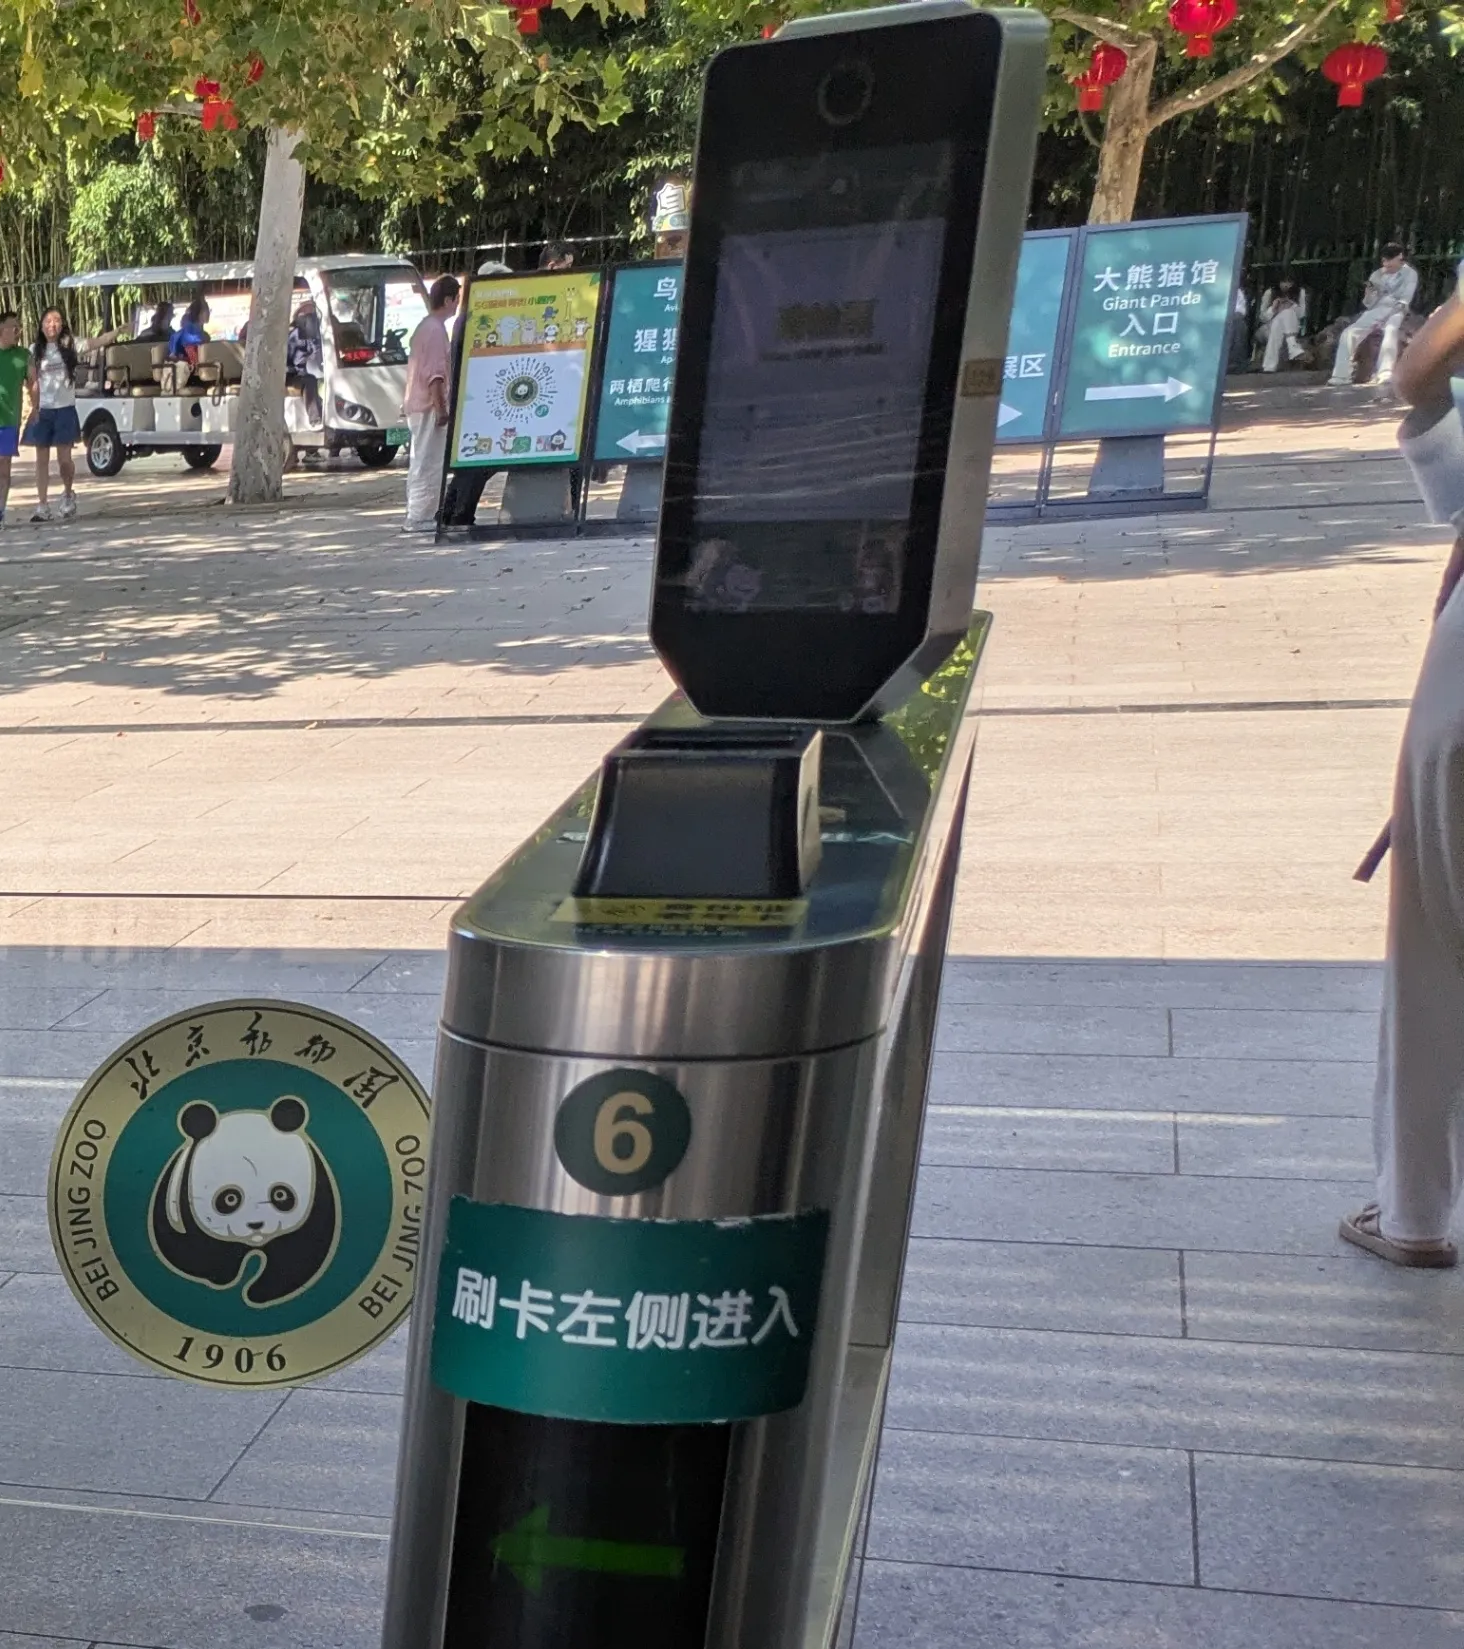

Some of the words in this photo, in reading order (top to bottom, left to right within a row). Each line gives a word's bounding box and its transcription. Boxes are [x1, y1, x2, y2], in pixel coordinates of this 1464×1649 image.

[1093, 259, 1219, 292] 大熊猫馆
[1102, 294, 1148, 312] Giant
[1150, 291, 1201, 308] Panda
[1119, 312, 1179, 337] 入口
[1107, 341, 1181, 358] Entrance
[70, 1119, 106, 1180] ZOO
[594, 1091, 653, 1175] 6
[67, 1186, 97, 1250] JING
[81, 1256, 120, 1302] BEI
[451, 1267, 800, 1350] 刷卡左侧进入
[173, 1336, 287, 1374] 1906
